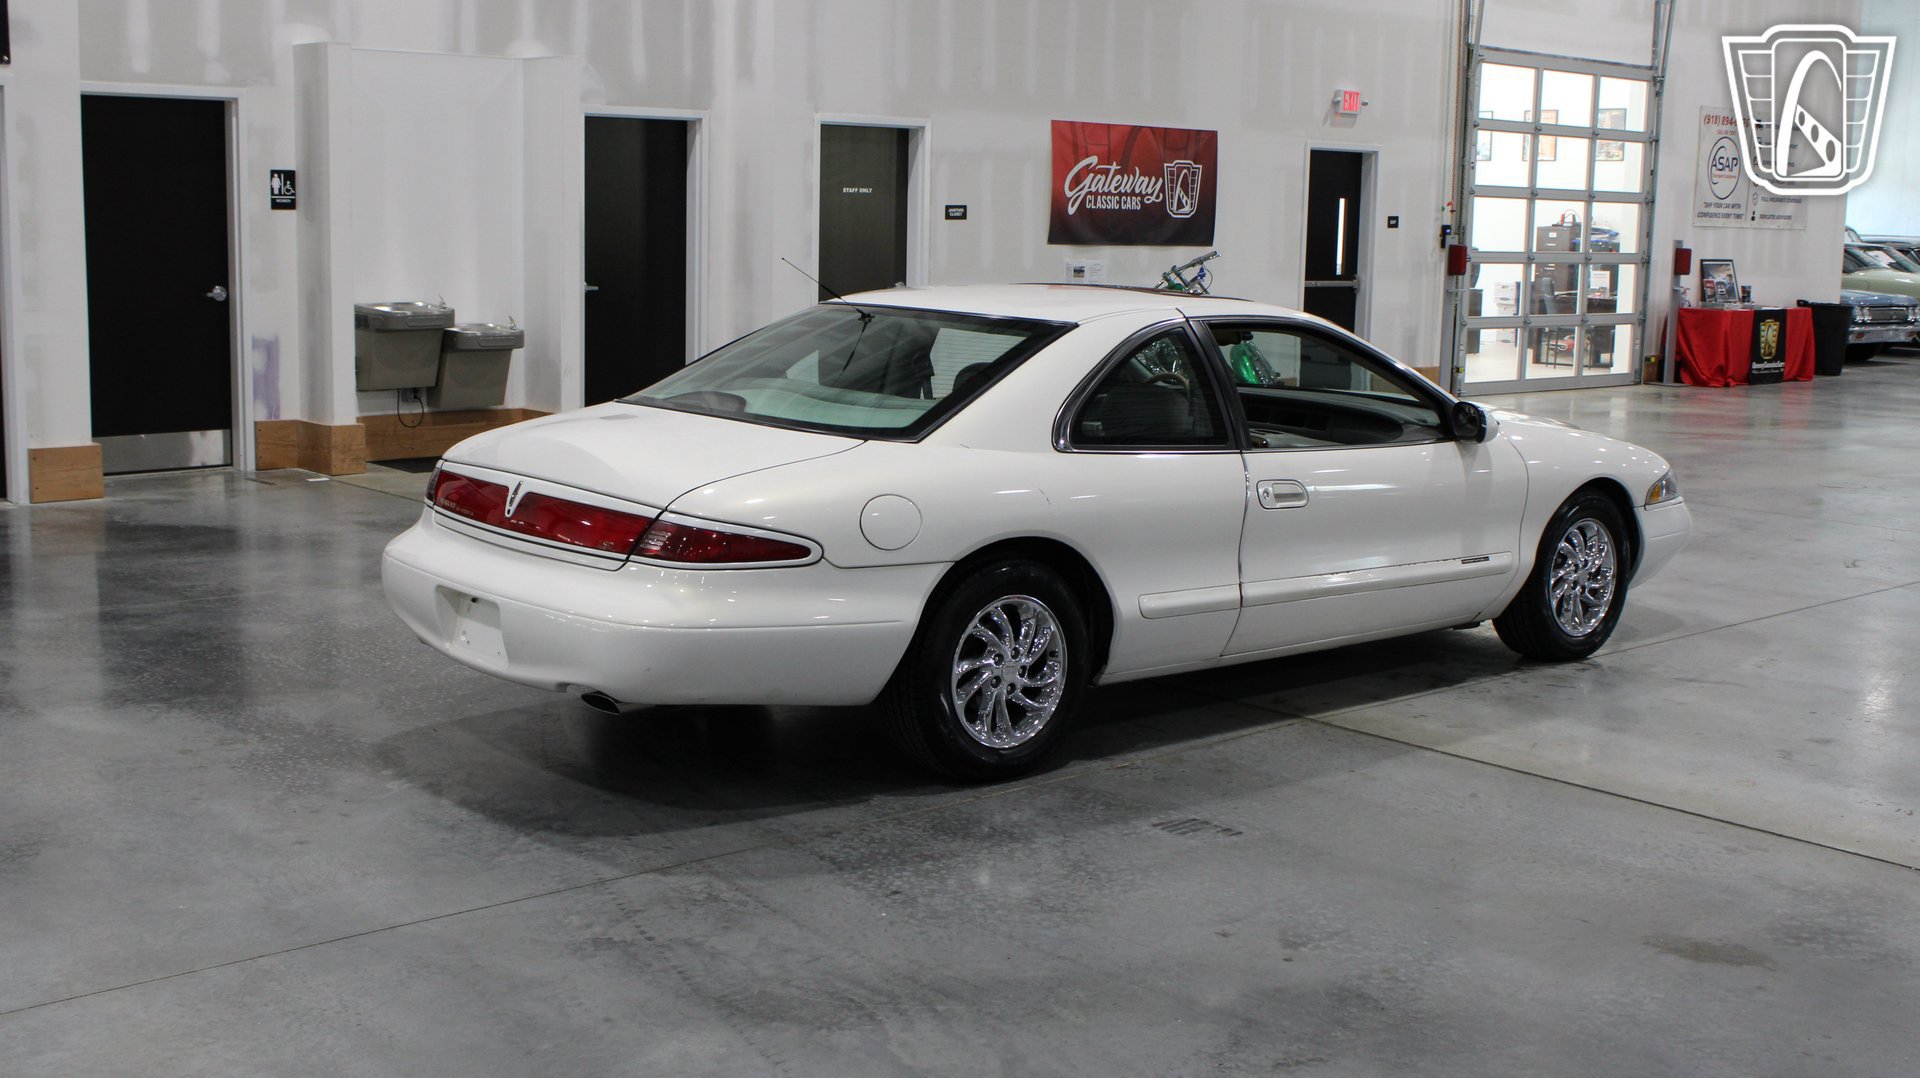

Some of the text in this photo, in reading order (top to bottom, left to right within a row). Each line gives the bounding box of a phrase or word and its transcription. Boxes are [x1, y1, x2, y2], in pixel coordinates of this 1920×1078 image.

[1343, 91, 1360, 111] EXIT
[1712, 156, 1739, 172] ASAP
[1064, 155, 1163, 216] Gateway
[1086, 194, 1141, 211] CLASSIC CARS
